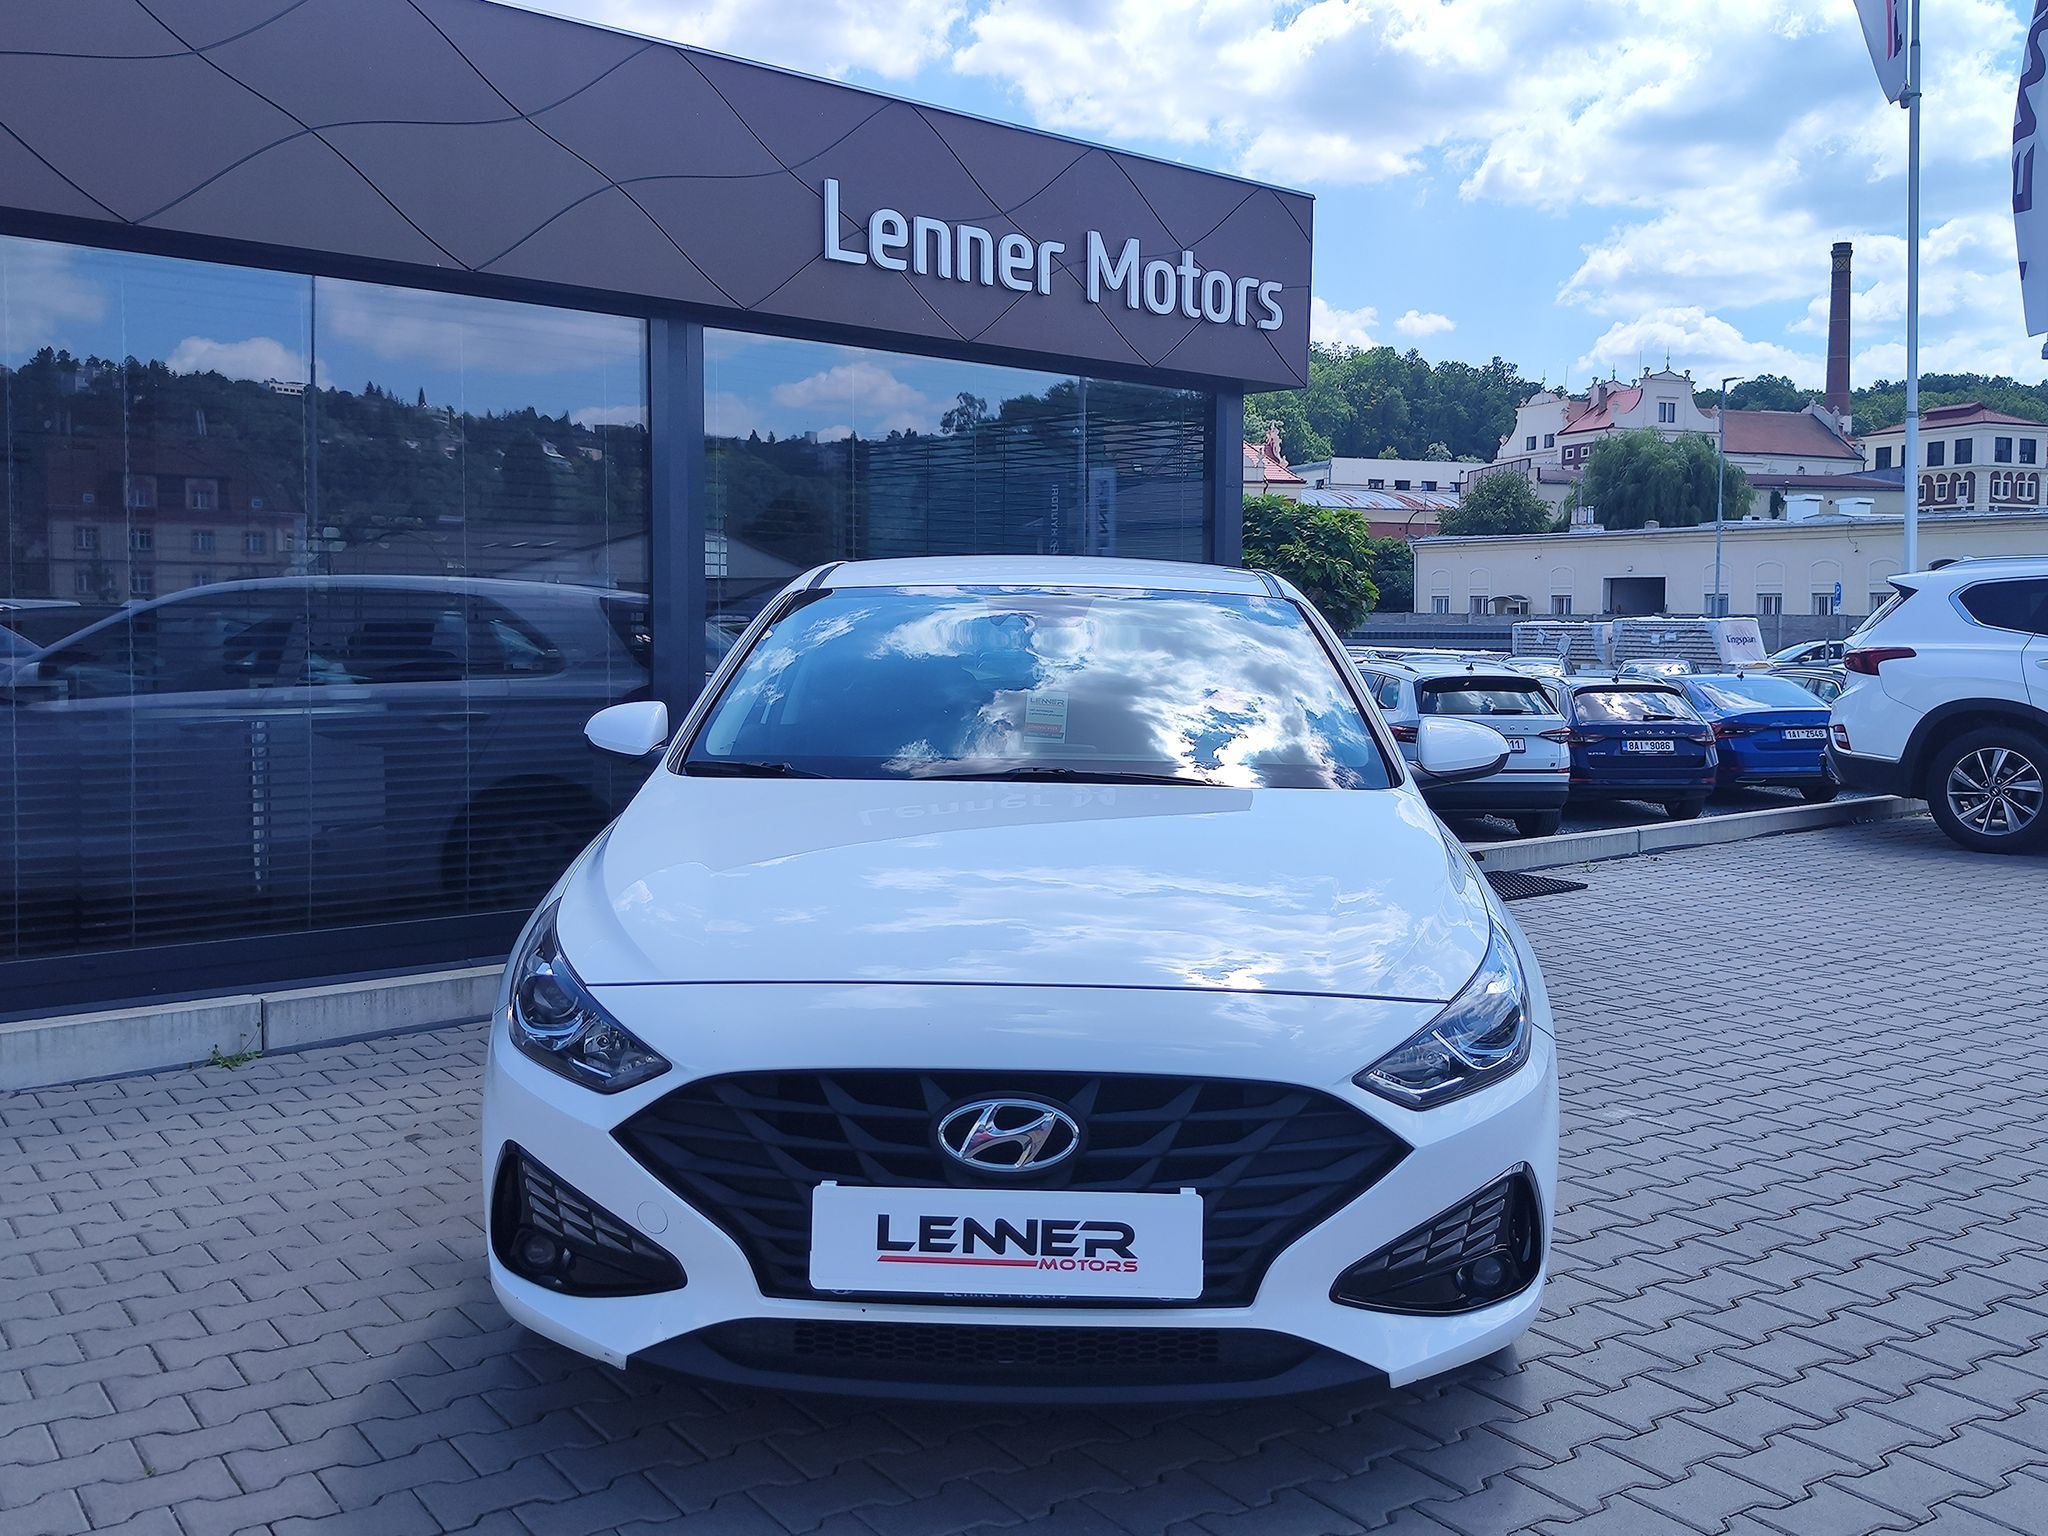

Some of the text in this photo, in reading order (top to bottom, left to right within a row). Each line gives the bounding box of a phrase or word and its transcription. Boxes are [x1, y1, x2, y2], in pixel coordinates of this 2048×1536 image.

[824, 178, 1284, 331] Lenner Motors
[1650, 741, 1671, 750] 9086
[877, 1214, 1138, 1259] LENNER
[1038, 1258, 1138, 1272] MOTORS
